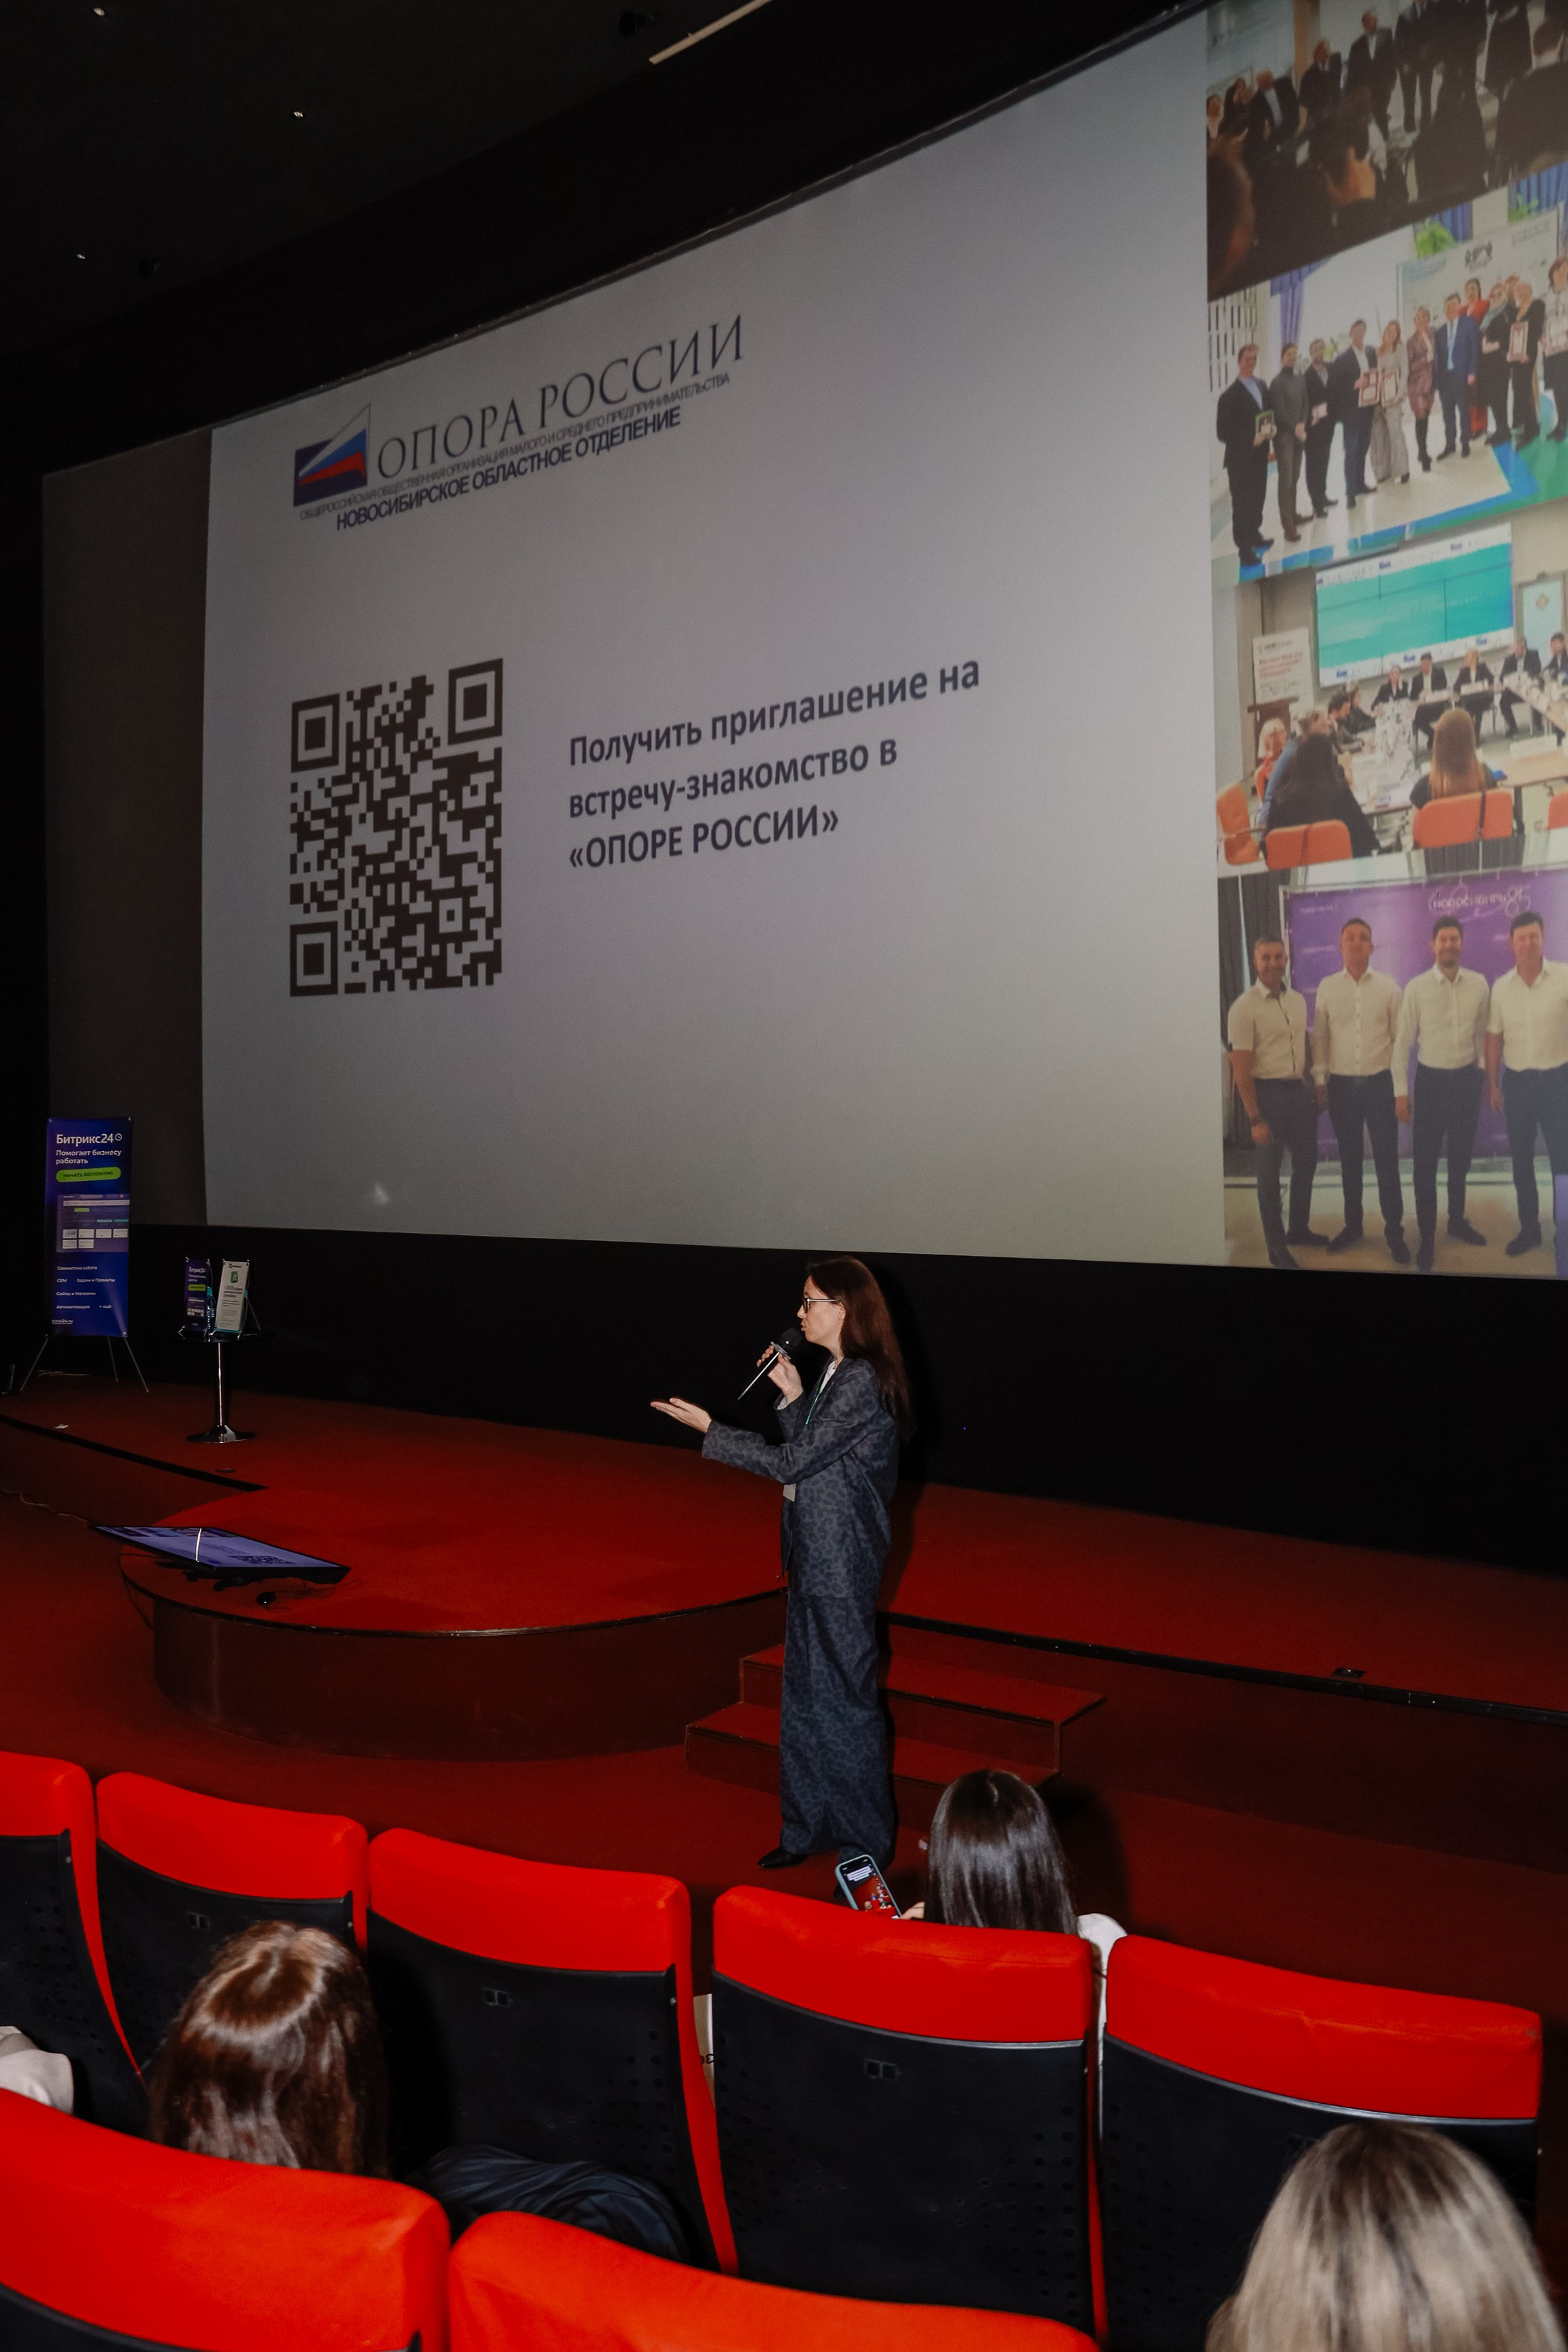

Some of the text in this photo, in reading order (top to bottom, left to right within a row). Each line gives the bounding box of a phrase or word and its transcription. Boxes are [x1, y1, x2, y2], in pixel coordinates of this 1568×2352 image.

[300, 489, 376, 520] ОБЩЕРОССИЙСКАЯ
[377, 468, 445, 497] ОБЩЕСТВЕННАЯ
[447, 447, 509, 477] ОРГАНИЗАЦИЯ
[510, 435, 547, 457] МАЛОГО
[557, 415, 605, 440] СРЕДНЕГО
[606, 373, 730, 424] ПРЕДПРИНИМАТЕЛЬСТВА
[378, 314, 741, 479] ОПОРА РОССИИ
[336, 406, 681, 530] НОВОСИБИРСКОЕ ОБЛАСТНОЕ ОТДЕЛЕНИЕ
[569, 660, 979, 765] Получить приглашение на
[569, 738, 897, 820] встречу-знакомство в
[569, 804, 839, 868] «ОПОРЕ РОССИИ»
[56, 1133, 114, 1147] Битрикс24
